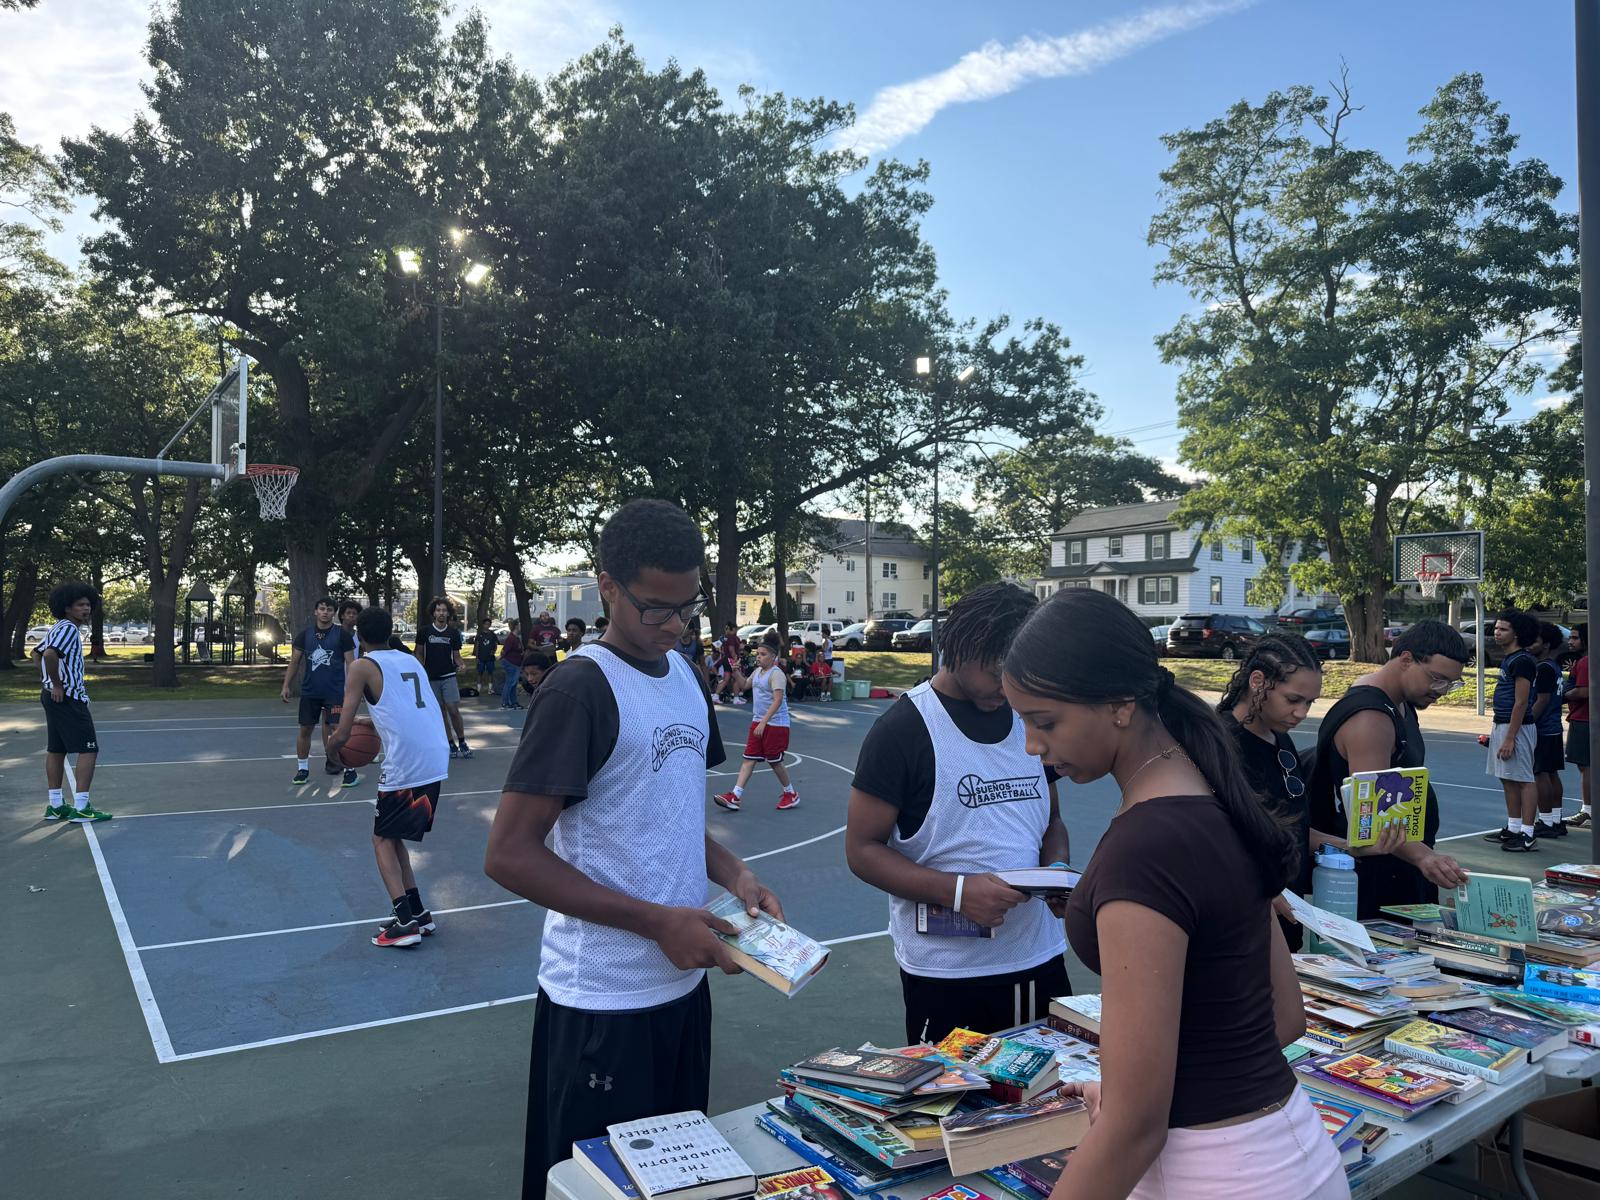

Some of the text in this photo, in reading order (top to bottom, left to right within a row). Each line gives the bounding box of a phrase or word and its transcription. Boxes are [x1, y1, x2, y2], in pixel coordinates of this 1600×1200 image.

[400, 671, 426, 709] 7
[659, 728, 682, 748] SUEÑOS
[660, 736, 700, 759] BASKETBALL
[975, 782, 1011, 794] SUEÑOS
[977, 789, 1034, 803] BASKETBALL
[618, 1118, 707, 1139] JACK KERLEY
[638, 1146, 732, 1169] HUNDREDTH
[661, 1142, 695, 1153] MAN
[679, 1163, 709, 1173] THE
